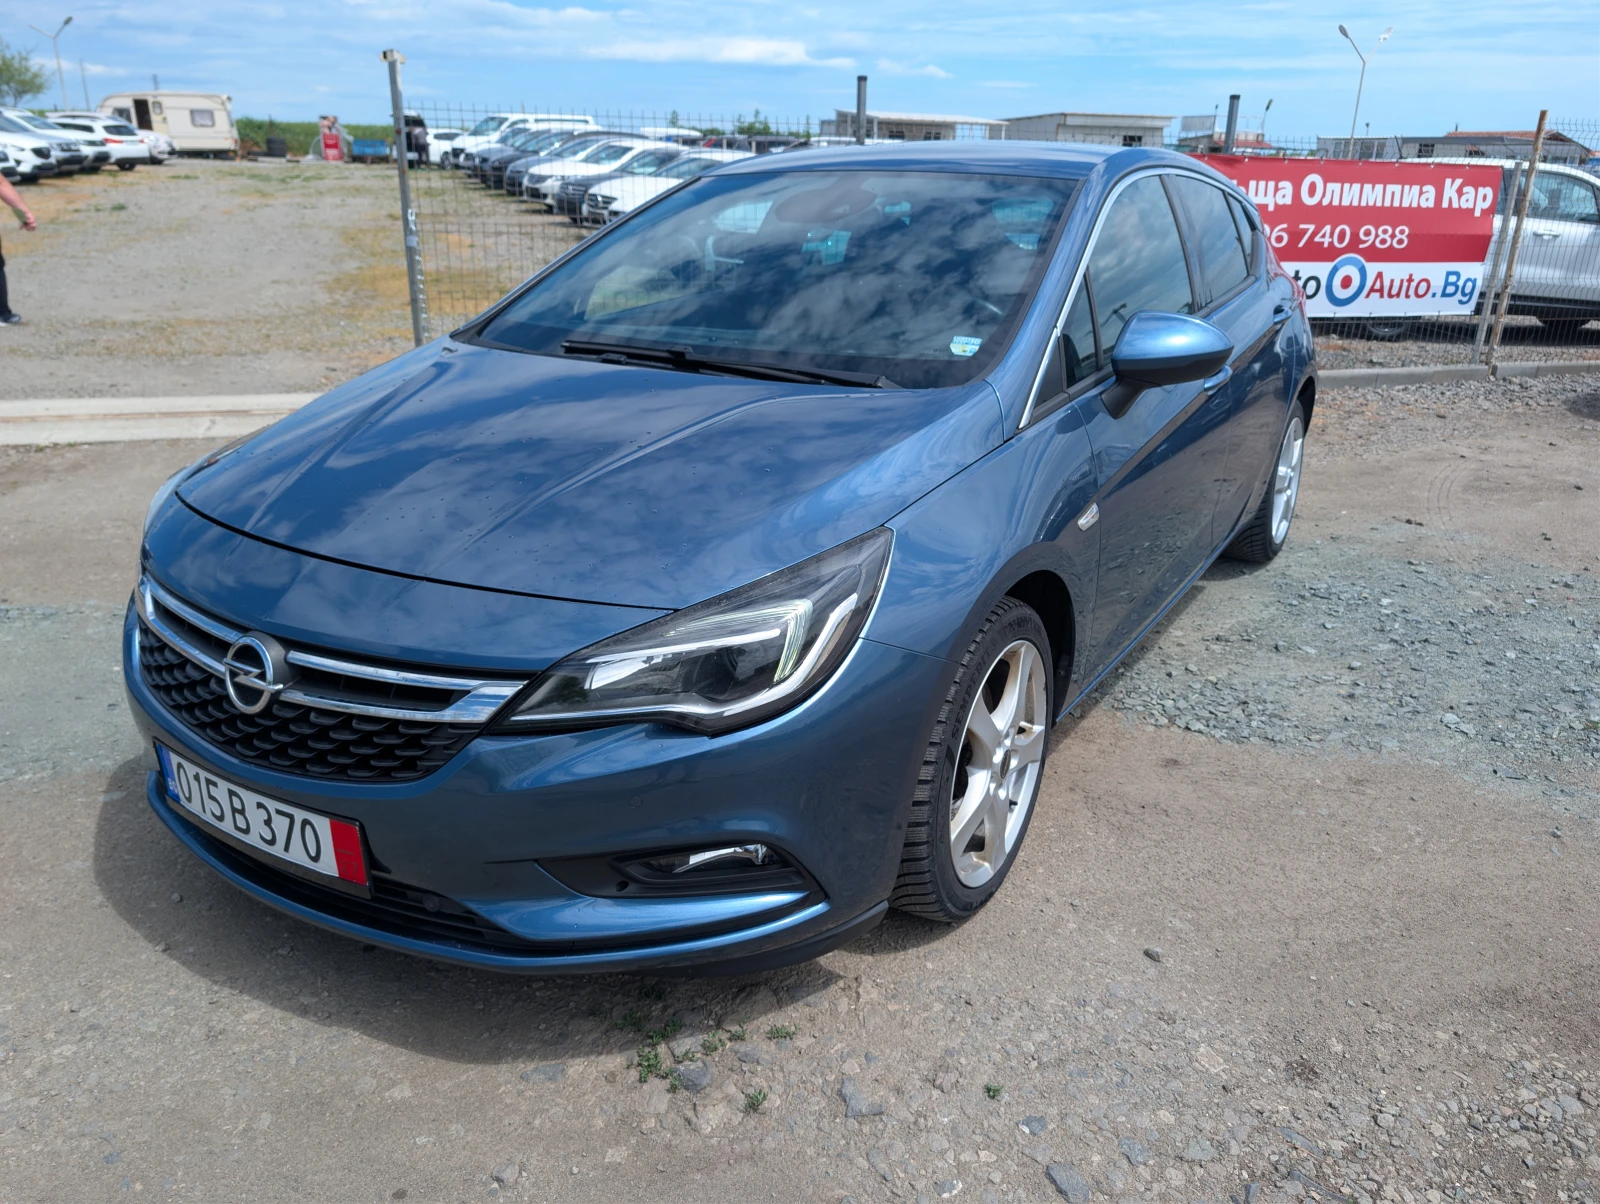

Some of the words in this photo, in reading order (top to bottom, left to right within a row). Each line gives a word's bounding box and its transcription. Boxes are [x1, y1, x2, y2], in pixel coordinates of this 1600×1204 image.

[1232, 179, 1293, 212] ща
[1300, 173, 1436, 208] Олимпиа
[1441, 178, 1494, 217] Кар
[1298, 224, 1351, 249] 740
[1358, 225, 1409, 249] 988
[1365, 270, 1478, 305] Auto.Bg
